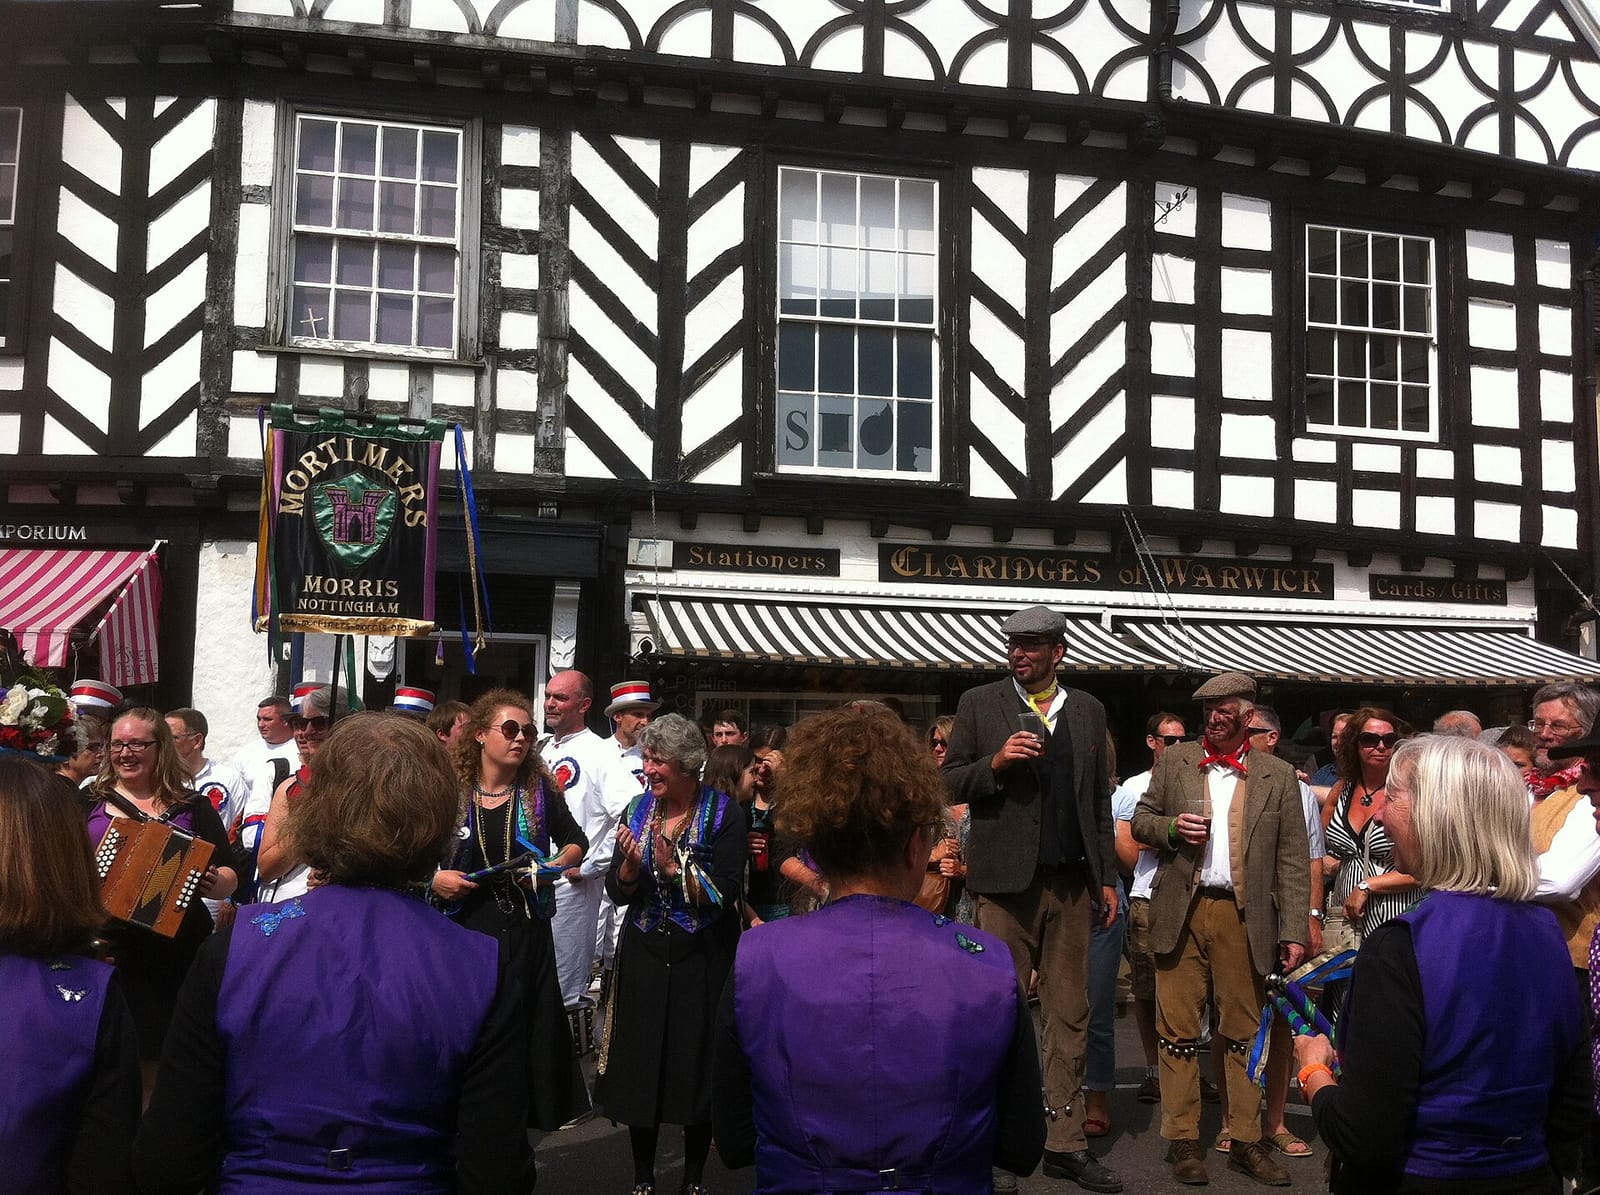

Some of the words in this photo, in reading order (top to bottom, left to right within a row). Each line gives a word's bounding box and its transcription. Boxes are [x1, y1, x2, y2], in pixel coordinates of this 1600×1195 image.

[279, 437, 428, 528] MORTIMERS
[687, 546, 826, 573] Stationers
[890, 546, 1102, 585] CLARIDGES
[1119, 563, 1146, 586] of
[1161, 557, 1322, 594] WARWICK
[303, 575, 400, 598] MORRIS
[298, 598, 400, 614] NOTTINGHAM
[675, 674, 737, 692] Printing
